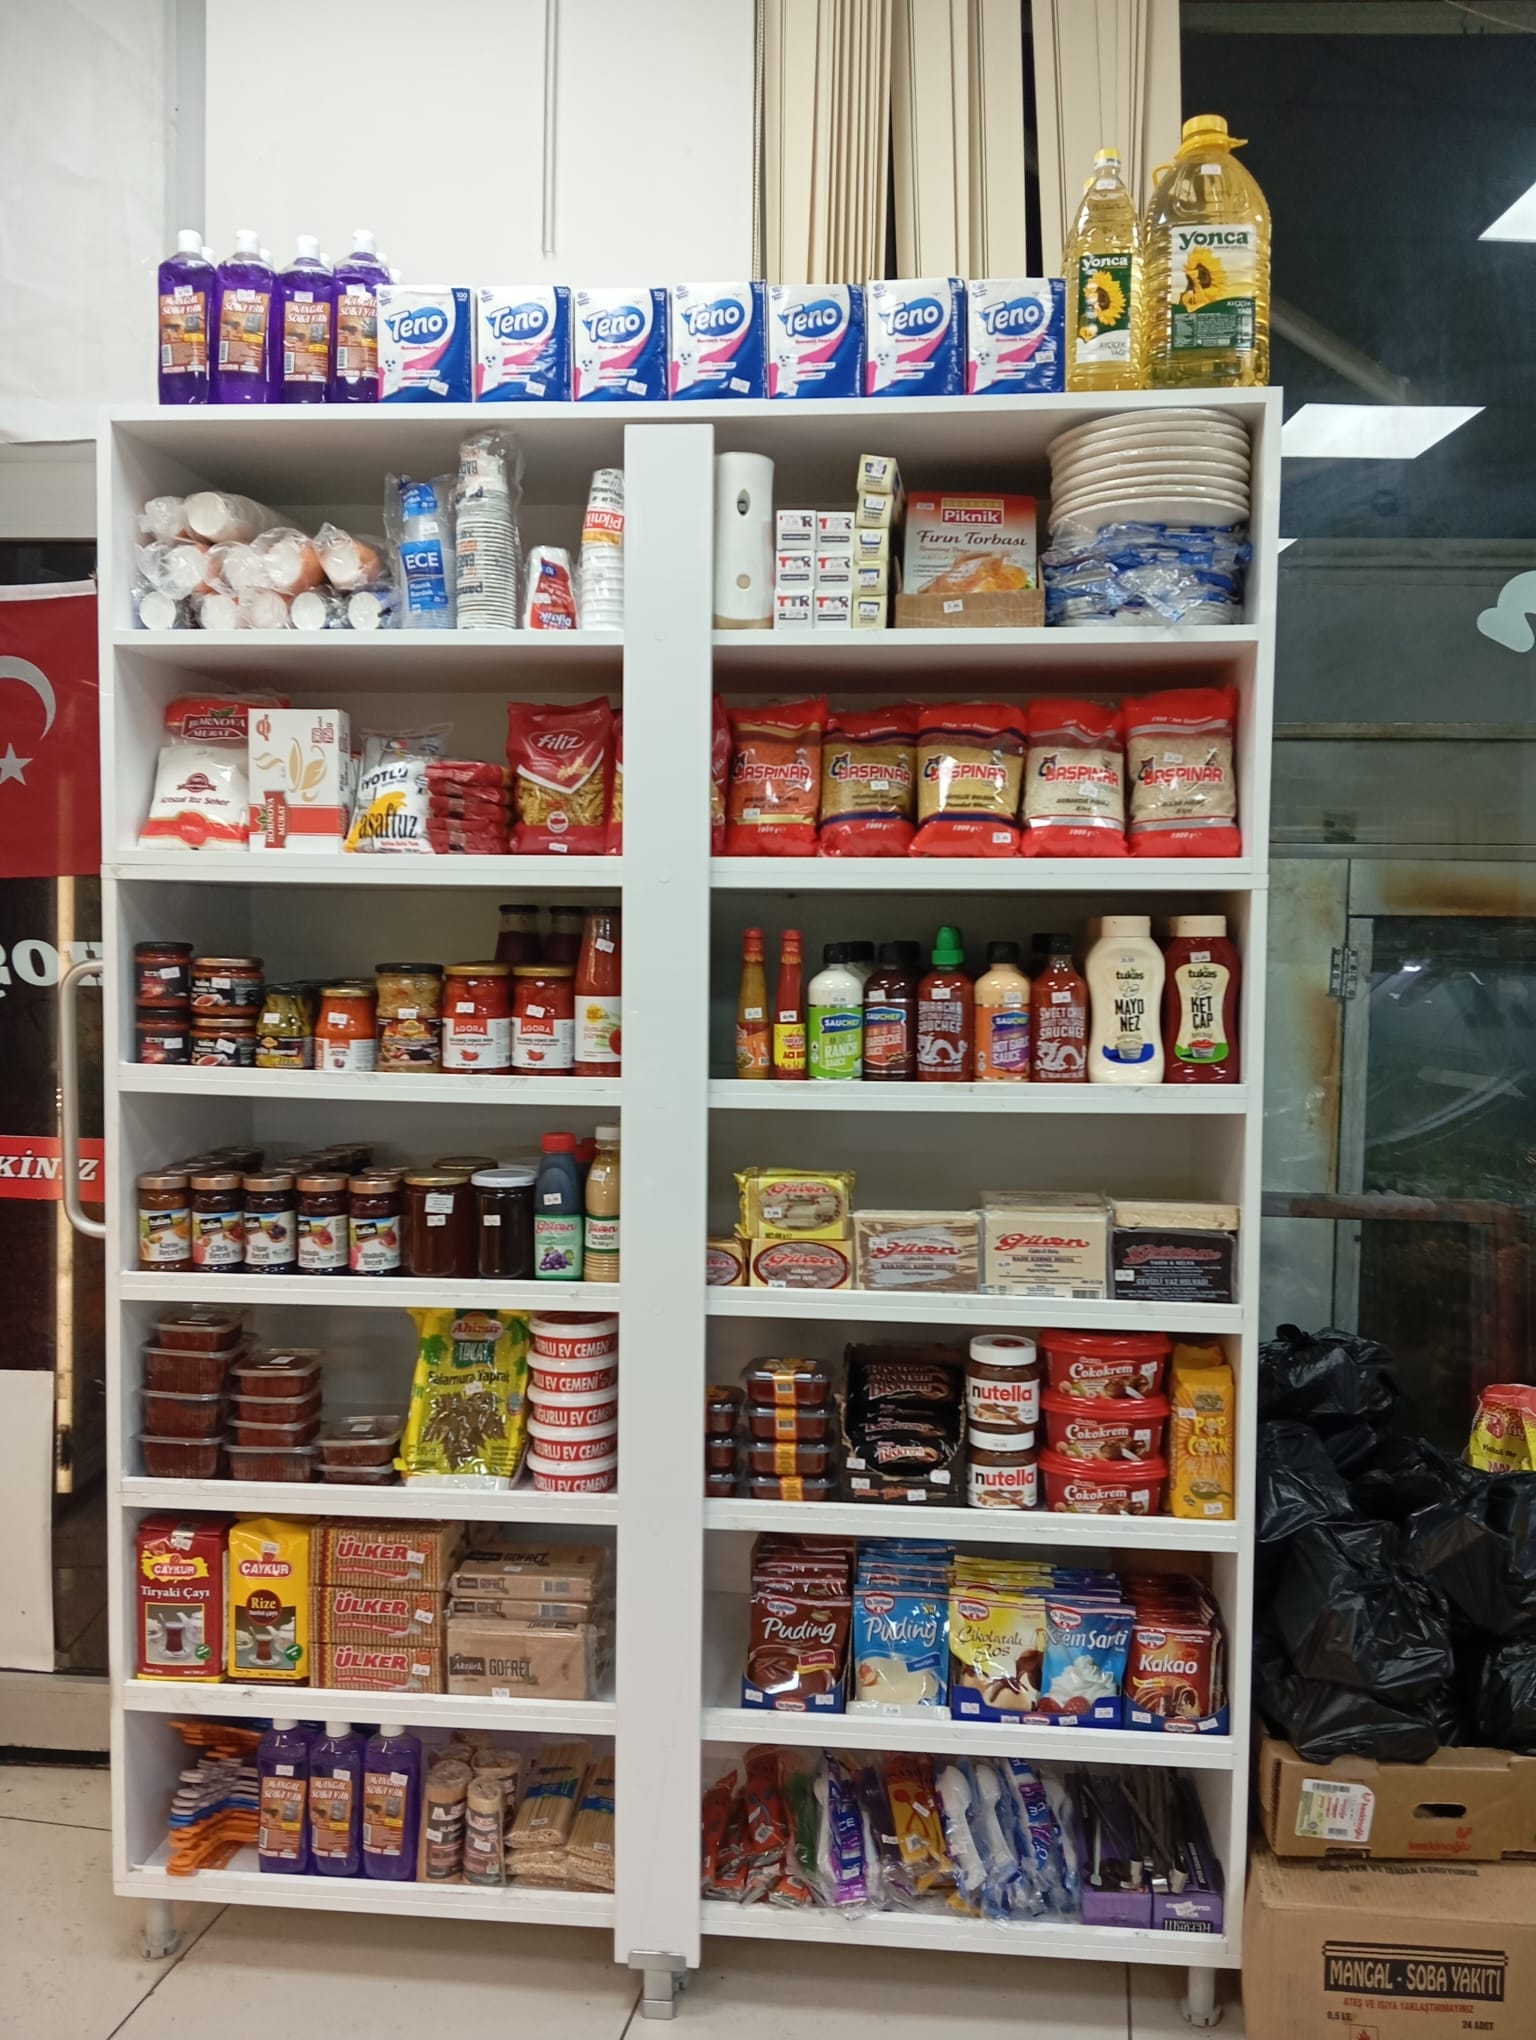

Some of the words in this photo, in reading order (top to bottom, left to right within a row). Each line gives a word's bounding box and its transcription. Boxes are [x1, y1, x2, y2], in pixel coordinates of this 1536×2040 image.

[1179, 231, 1248, 250] yonca
[1082, 257, 1127, 270] yonca
[390, 310, 442, 342] Teno
[491, 307, 543, 338] Teno
[587, 312, 638, 342] Teno
[688, 306, 739, 335] Teno
[785, 304, 838, 336] Teno
[887, 303, 939, 335] Teno
[986, 303, 1037, 335] Teno
[944, 510, 998, 523] Piknik
[917, 530, 961, 543] Fırın
[965, 532, 1027, 546] Torbası
[405, 552, 440, 569] ECE
[777, 595, 809, 607] TTR
[188, 716, 246, 729] BORNOVA
[267, 797, 275, 844] BORNOVA
[278, 805, 286, 835] MURAT
[1115, 999, 1144, 1015] MAYO
[1191, 996, 1212, 1013] KET
[455, 1025, 485, 1033] AGORA
[522, 1025, 551, 1033] AGORA
[1120, 1016, 1141, 1032] NEZ
[0, 1149, 99, 1181] KİNZ
[559, 1343, 572, 1357] EV
[1069, 1362, 1133, 1382] Çokokrem
[546, 1378, 557, 1390] EV
[972, 1385, 1032, 1401] nutella
[570, 1411, 584, 1425] EV
[1065, 1424, 1129, 1443] Çokokrem
[563, 1447, 576, 1460] EV
[975, 1469, 1034, 1485] nutella
[1064, 1485, 1127, 1505] Çokokrem
[337, 1535, 409, 1561] ÜLKER
[153, 1565, 195, 1575] ÇAYKUR
[241, 1564, 289, 1576] ÇAYKUR
[141, 1586, 180, 1600] Tiryaki
[183, 1588, 210, 1600] Çayı
[251, 1597, 276, 1609] Rize
[335, 1591, 408, 1616] ÜLKER
[762, 1617, 836, 1644] Puding
[864, 1617, 937, 1647] Puding
[1087, 1630, 1128, 1650] Şanti
[336, 1645, 408, 1672] ÜLKER
[1139, 1653, 1198, 1674] Kakao
[489, 1659, 532, 1677] GOFRET
[1330, 1959, 1393, 1989] MANGAL
[1406, 1962, 1447, 1992] SOBA
[1450, 1966, 1501, 1996] YAKITI
[1343, 1997, 1363, 2008] ATEŞ
[1365, 2000, 1375, 2008] VE
[1462, 2020, 1472, 2030] 24
[1474, 2021, 1496, 2031] ADET
